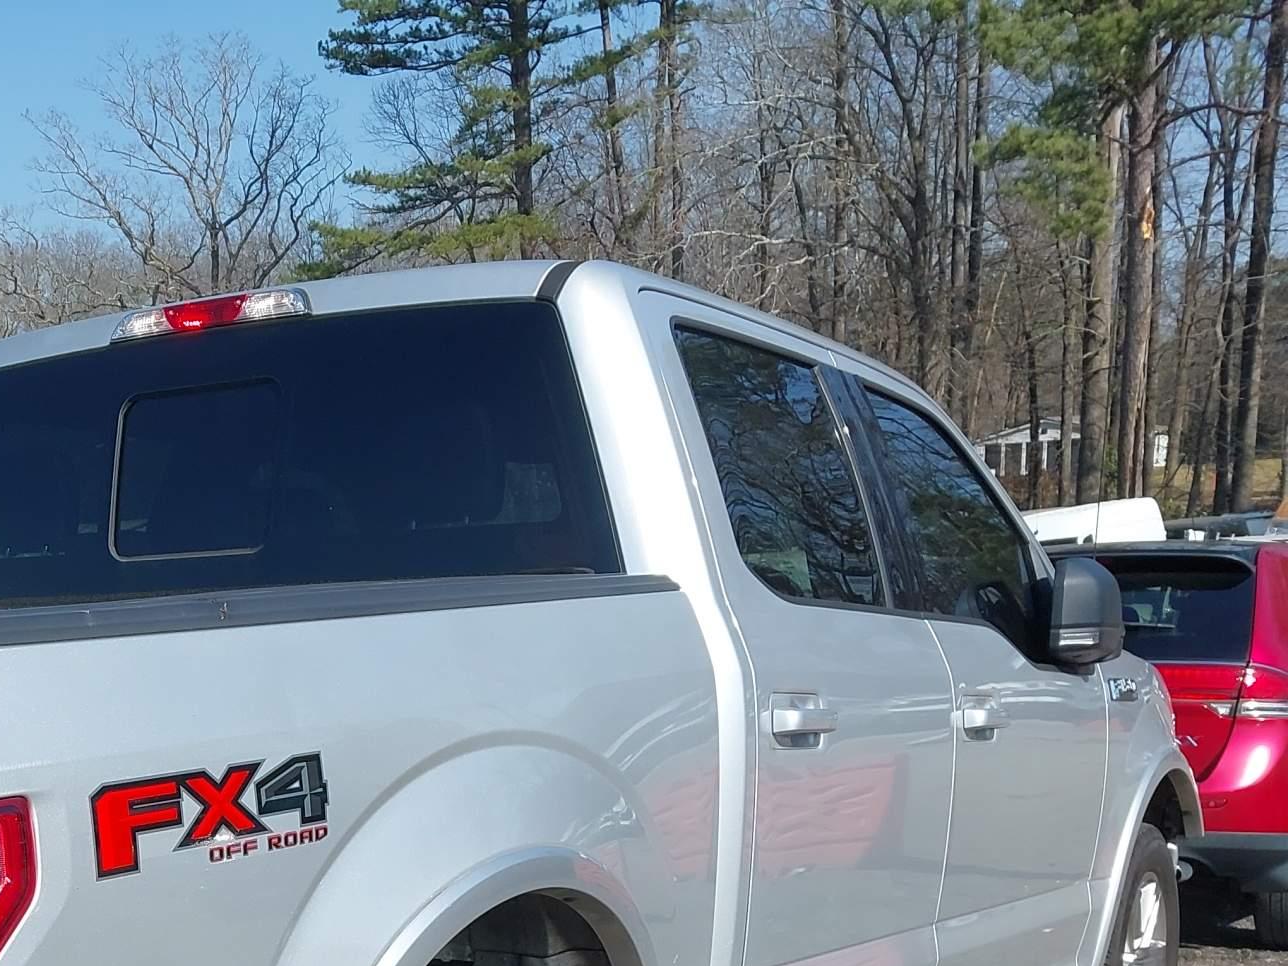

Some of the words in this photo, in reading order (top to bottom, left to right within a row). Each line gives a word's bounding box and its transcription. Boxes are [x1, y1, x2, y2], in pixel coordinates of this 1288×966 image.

[89, 750, 329, 882] FX4
[209, 839, 259, 863] OFF
[268, 825, 328, 850] ROAD
